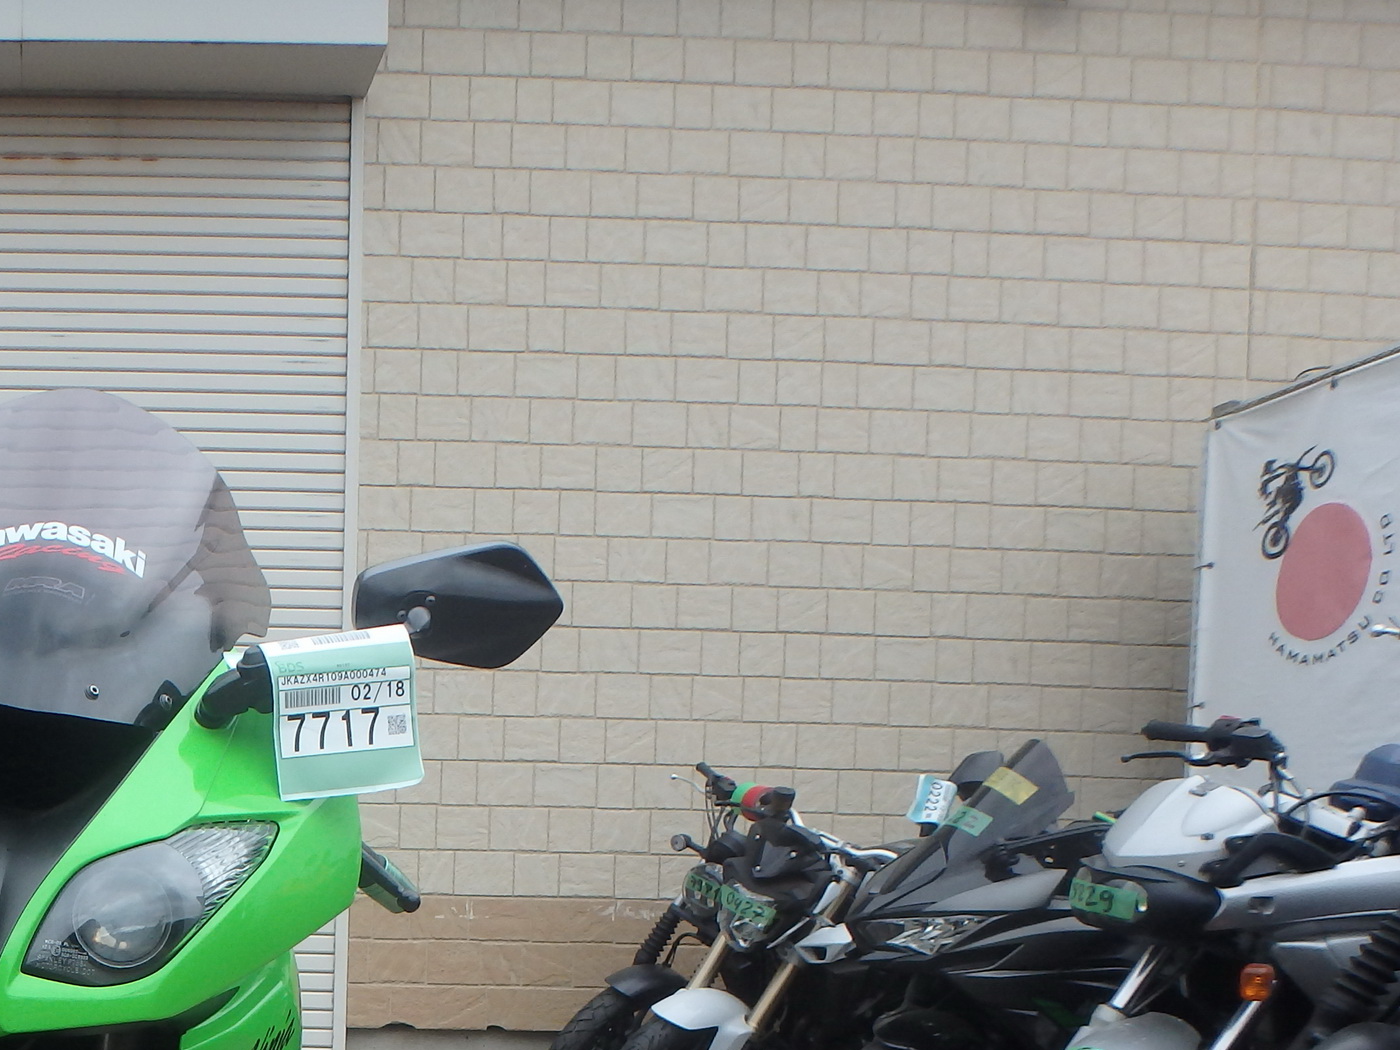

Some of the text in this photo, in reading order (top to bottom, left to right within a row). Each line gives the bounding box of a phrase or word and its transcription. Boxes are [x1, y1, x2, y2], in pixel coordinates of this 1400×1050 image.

[1268, 615, 1372, 665] HAMAMATSU
[281, 667, 387, 686] JKAZX4R109A000474
[351, 680, 405, 703] 02/18
[287, 707, 380, 753] 7717
[924, 781, 943, 812] 0222
